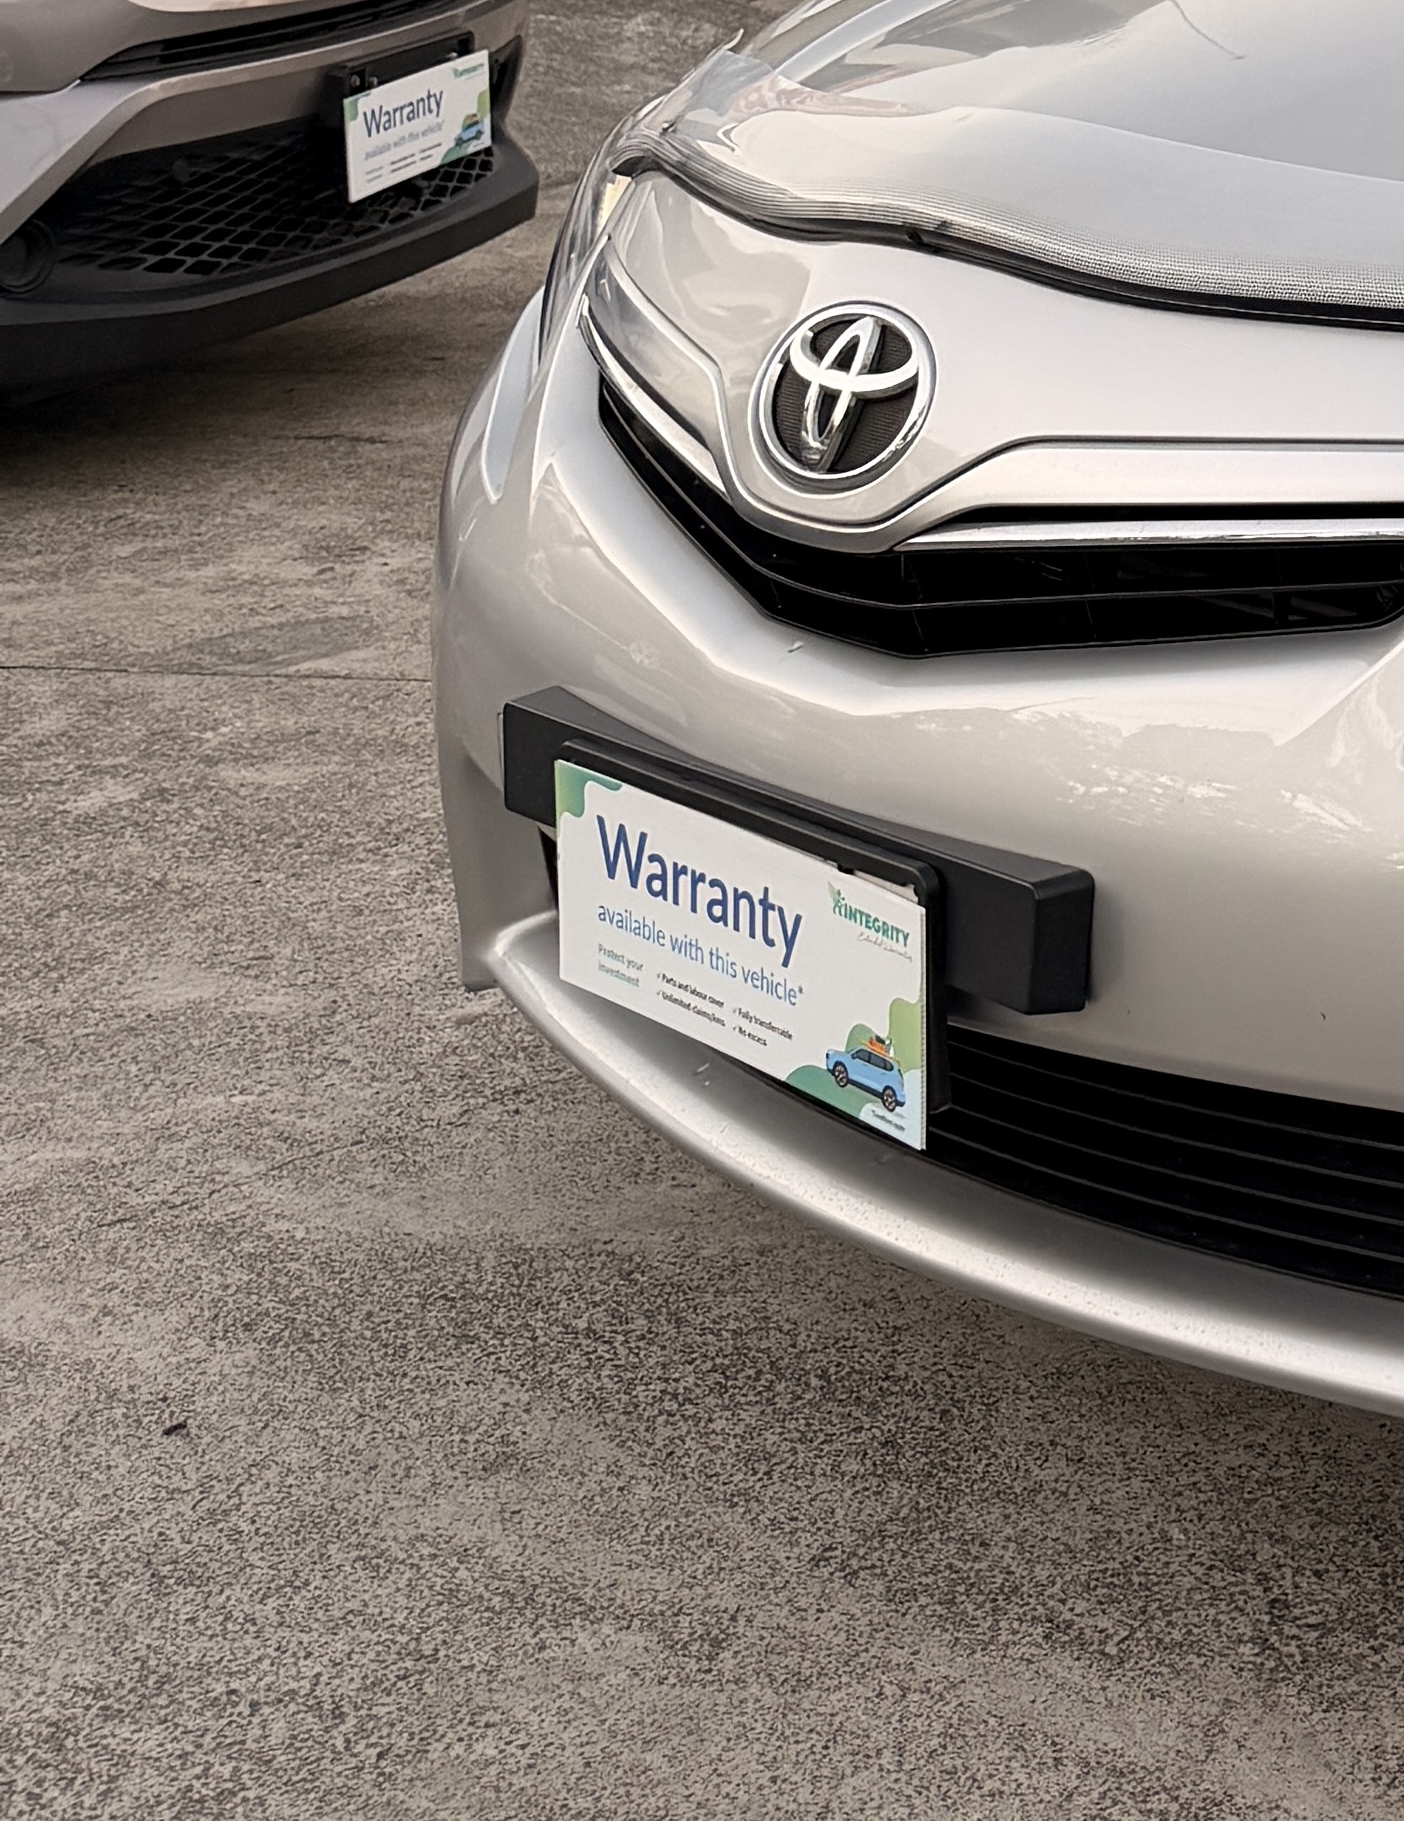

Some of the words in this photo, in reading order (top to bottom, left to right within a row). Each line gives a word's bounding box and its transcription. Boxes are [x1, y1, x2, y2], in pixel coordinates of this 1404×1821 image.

[363, 88, 444, 138] Warranty
[596, 814, 803, 968] Warranty
[597, 904, 666, 947] available
[670, 934, 705, 965] with
[709, 946, 737, 979] this
[843, 902, 910, 948] INTEGRITY
